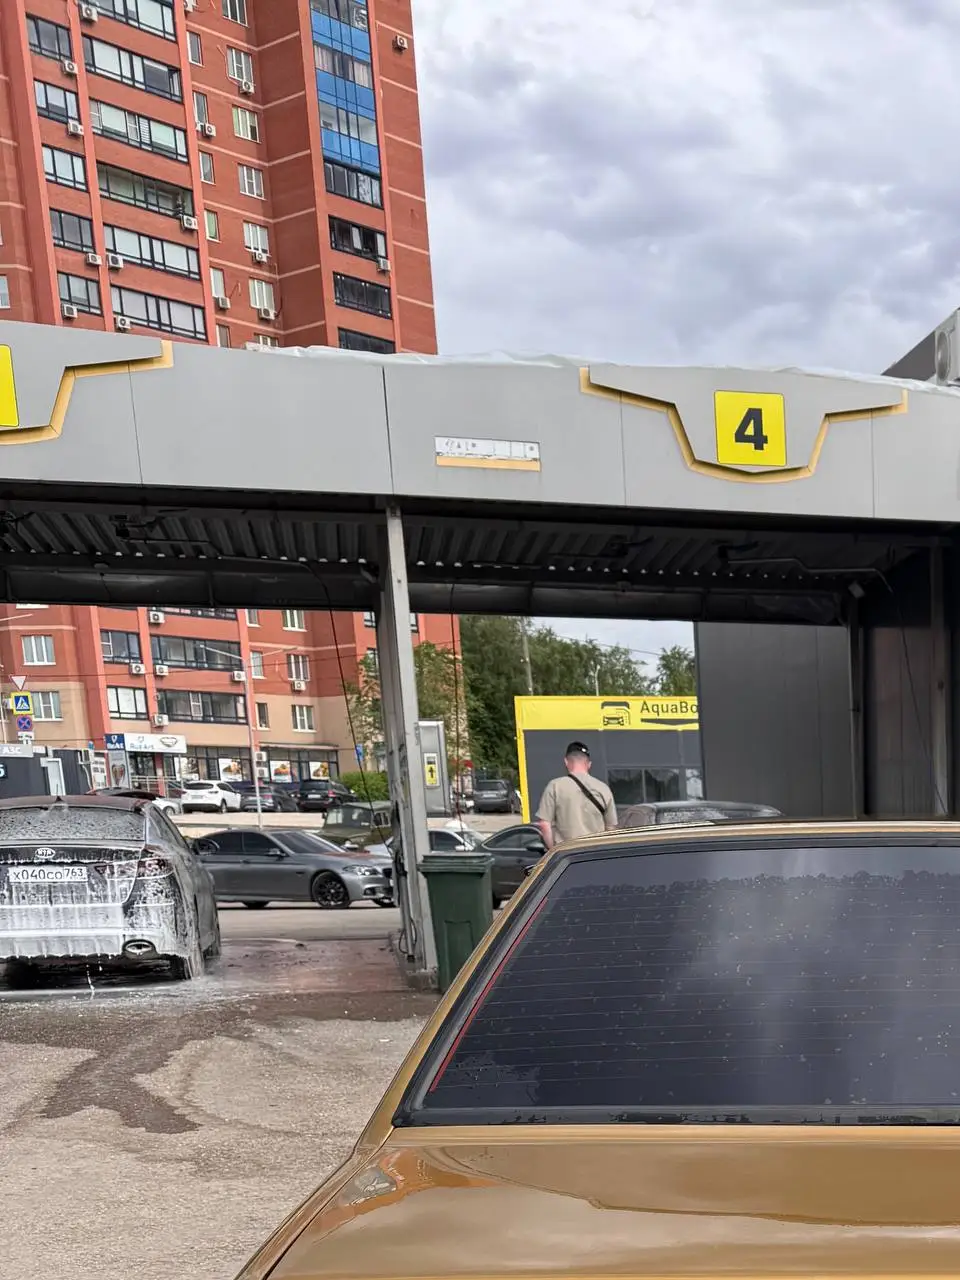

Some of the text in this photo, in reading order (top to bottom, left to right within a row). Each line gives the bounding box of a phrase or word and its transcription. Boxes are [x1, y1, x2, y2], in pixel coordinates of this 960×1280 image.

[734, 407, 768, 450] 4
[640, 700, 698, 716] AquaBo
[65, 868, 83, 877] 763
